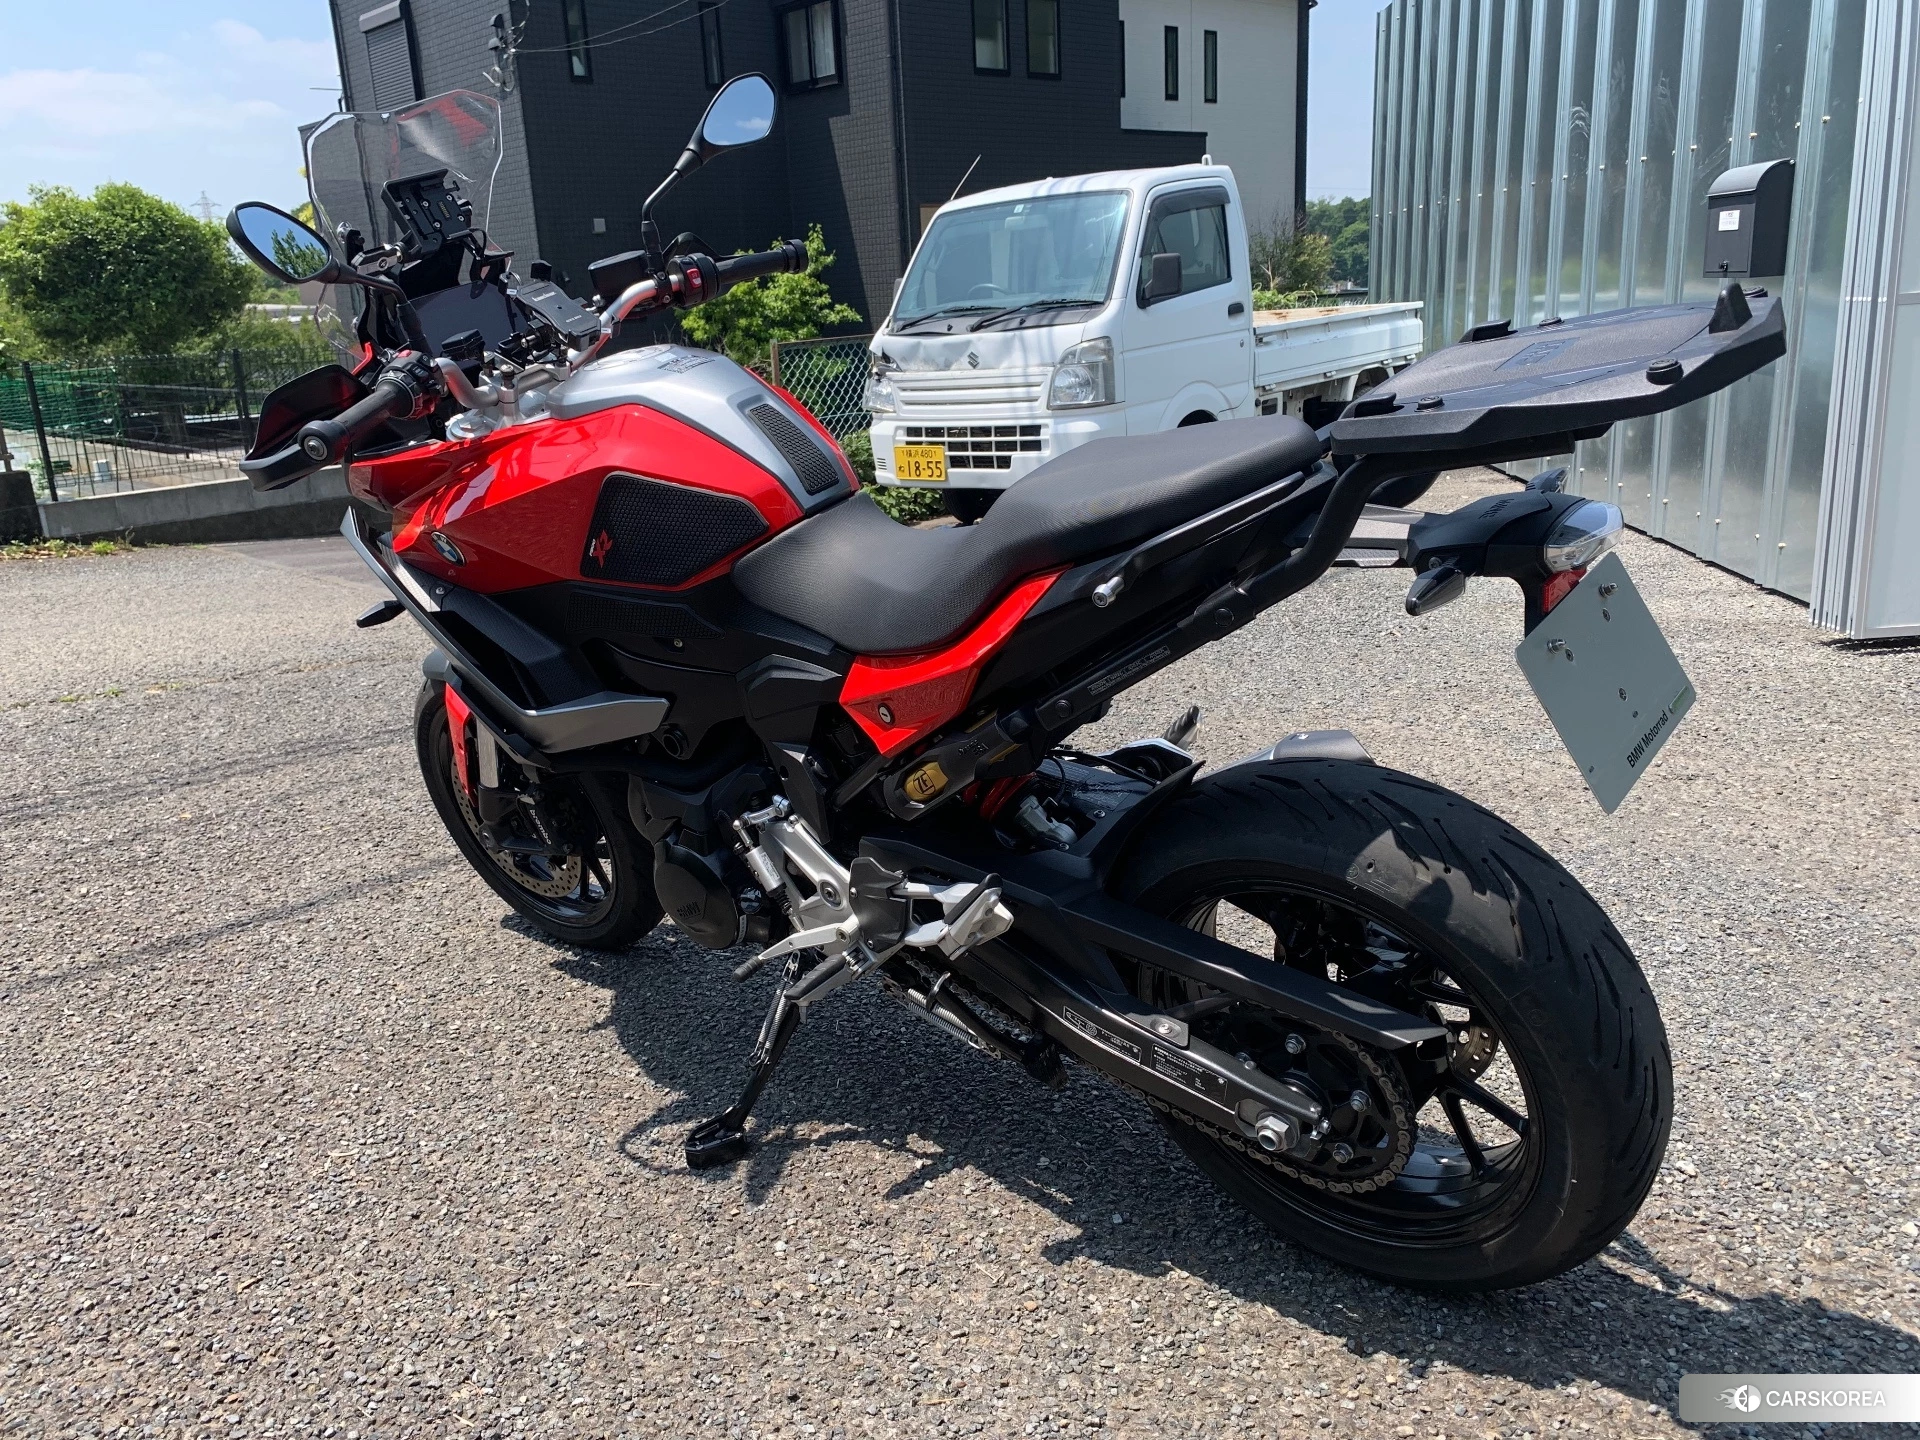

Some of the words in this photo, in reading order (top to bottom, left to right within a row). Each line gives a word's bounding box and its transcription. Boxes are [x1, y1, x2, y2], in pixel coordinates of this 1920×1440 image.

[907, 460, 942, 478] 18-55
[1626, 741, 1645, 768] BMW
[1641, 709, 1668, 748] Motorrad
[913, 772, 934, 793] ZF
[530, 809, 552, 845] brembo
